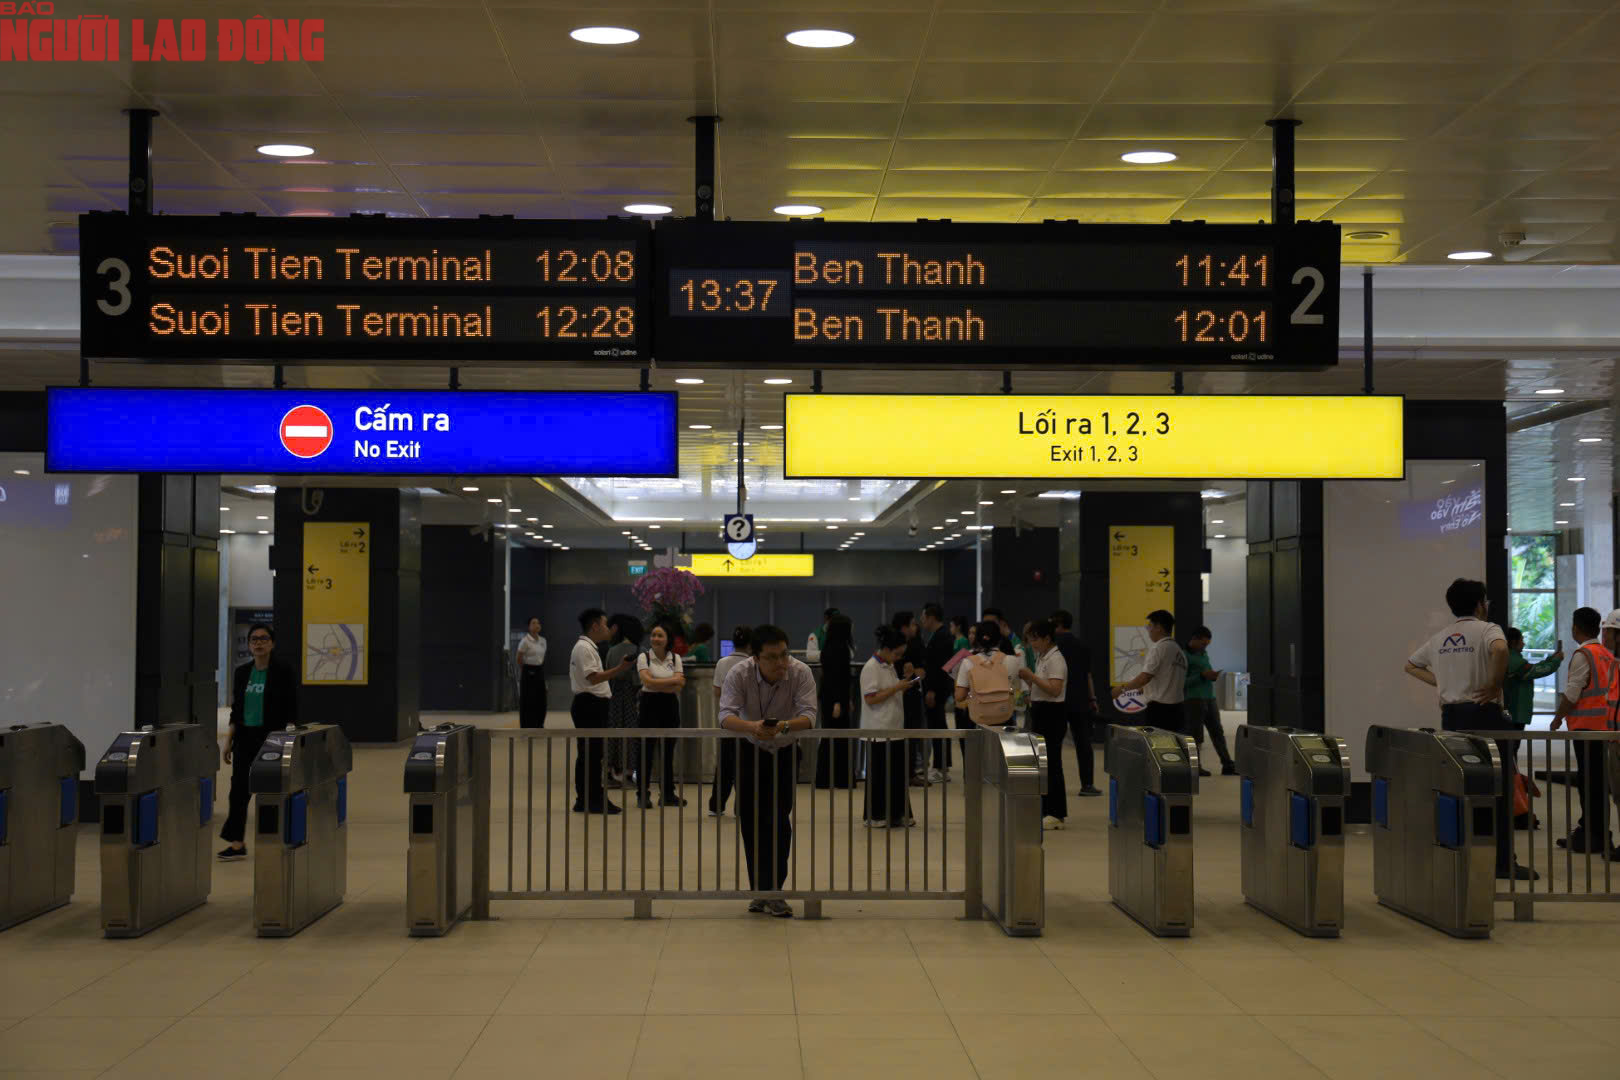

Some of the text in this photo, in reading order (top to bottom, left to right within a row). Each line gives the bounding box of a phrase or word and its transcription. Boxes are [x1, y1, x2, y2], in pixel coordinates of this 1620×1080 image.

[149, 247, 634, 282] Suoi Tien Terminal 12:08
[794, 253, 1267, 286] Ben Thanh 11:41
[97, 259, 131, 316] 3
[681, 279, 778, 311] 13:37
[1290, 266, 1324, 324] 2
[149, 304, 634, 338] Suoi Tien Terminal 12:28
[794, 309, 1267, 342] Ben Thanh 12:01
[355, 403, 450, 432] Cấm ra
[1020, 408, 1170, 436] Lối ra 1, 2, 3
[354, 440, 421, 458] No Exit
[1051, 445, 1083, 462] Exit
[1128, 445, 1138, 462] 3
[359, 542, 366, 553] 2
[1131, 545, 1138, 556] 3
[325, 578, 332, 590] 3
[1163, 581, 1170, 592] 2
